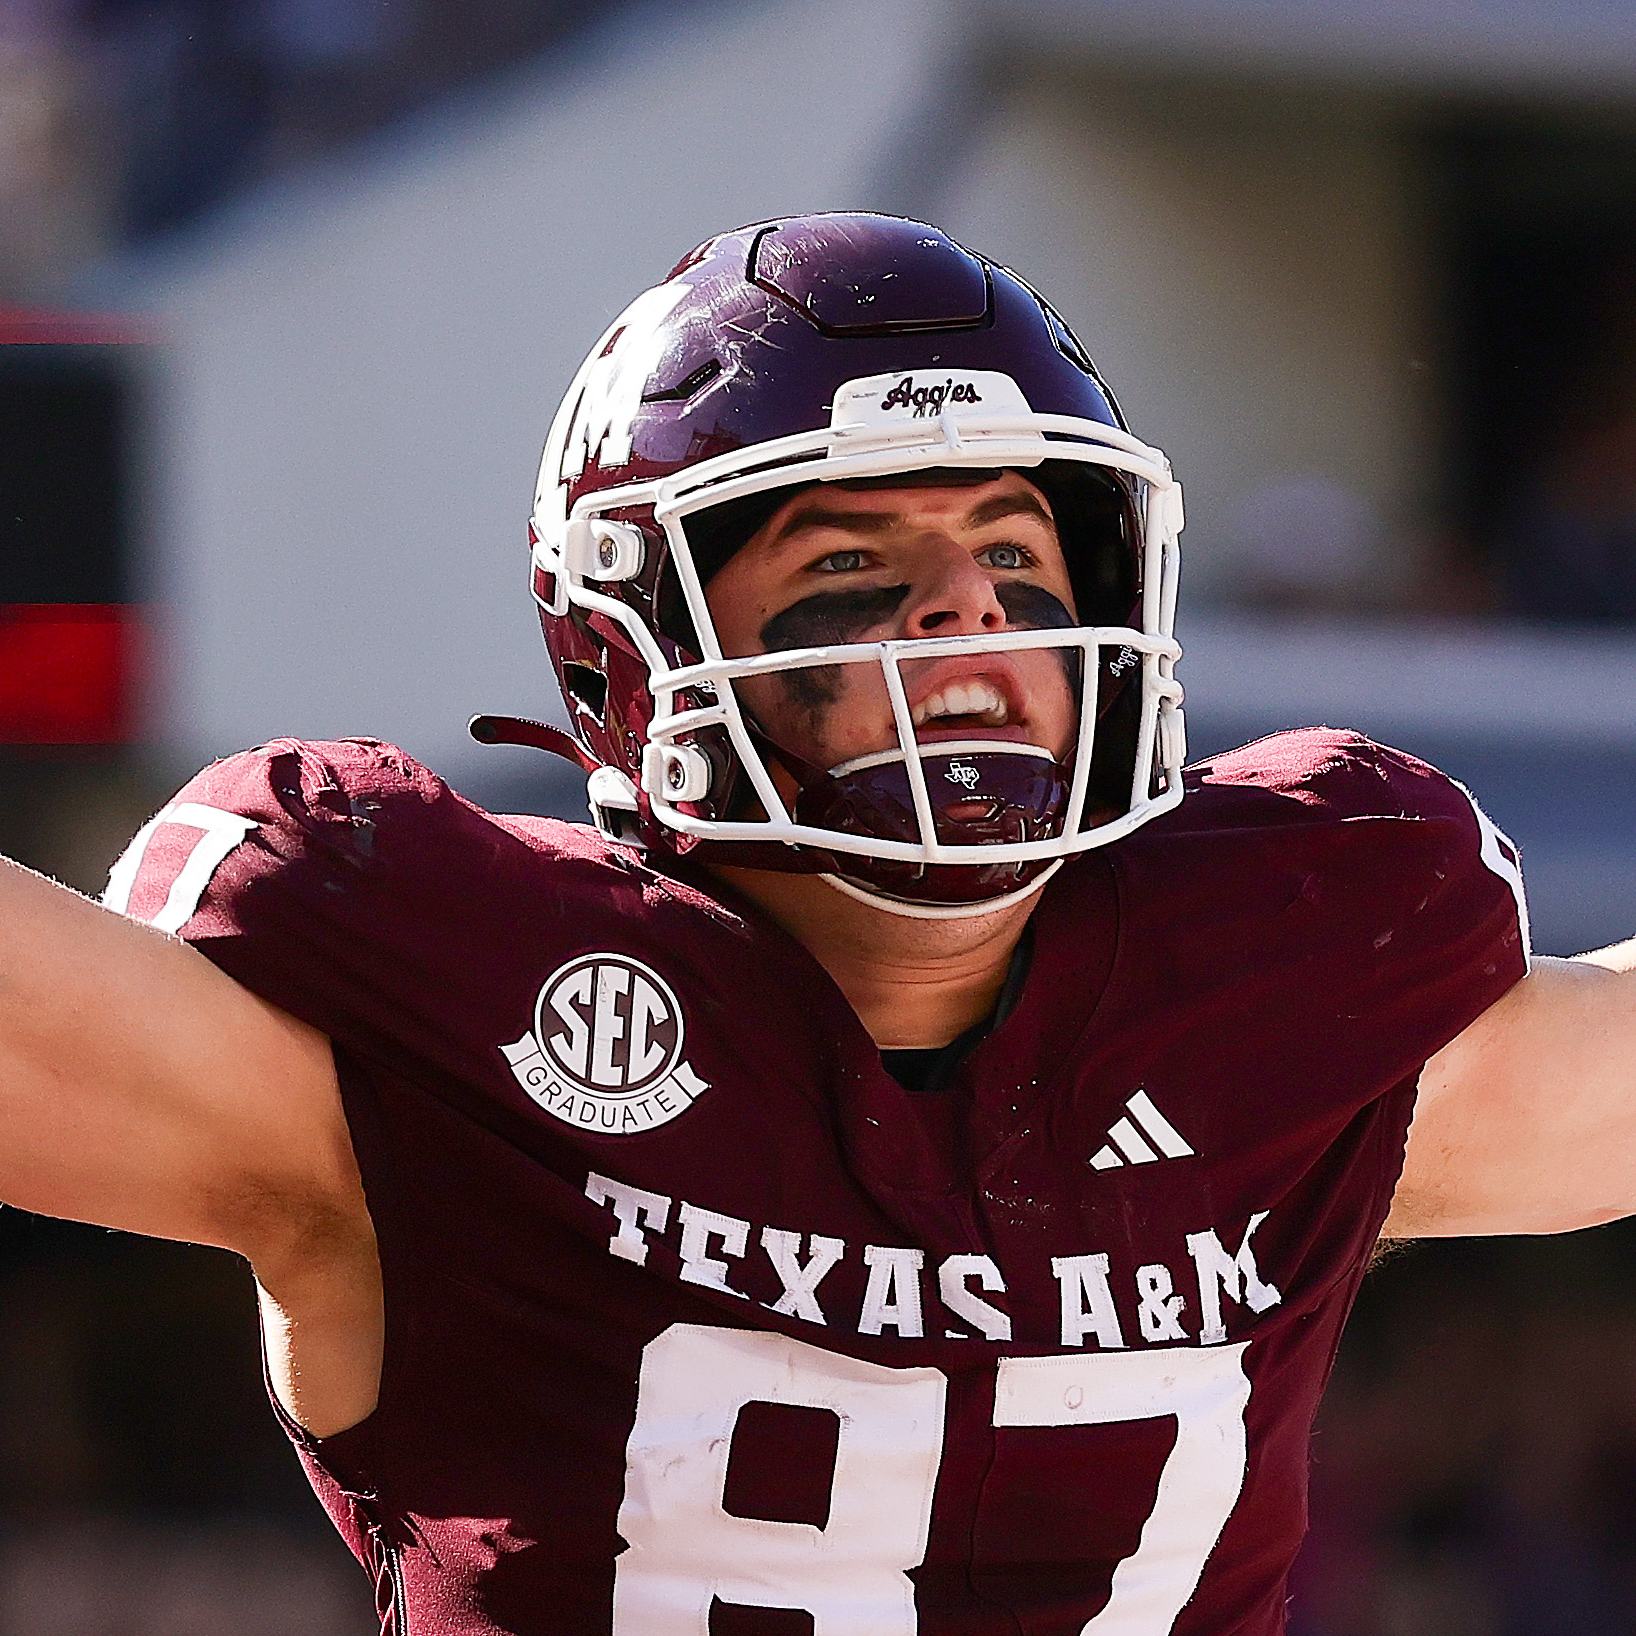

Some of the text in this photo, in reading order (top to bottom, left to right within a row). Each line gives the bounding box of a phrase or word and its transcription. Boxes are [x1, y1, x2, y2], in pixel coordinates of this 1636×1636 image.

[881, 376, 982, 418] Aggies
[549, 965, 670, 1086] SEC
[525, 1066, 677, 1128] GRADUATE
[585, 1172, 1282, 1347] TEXAS A&M
